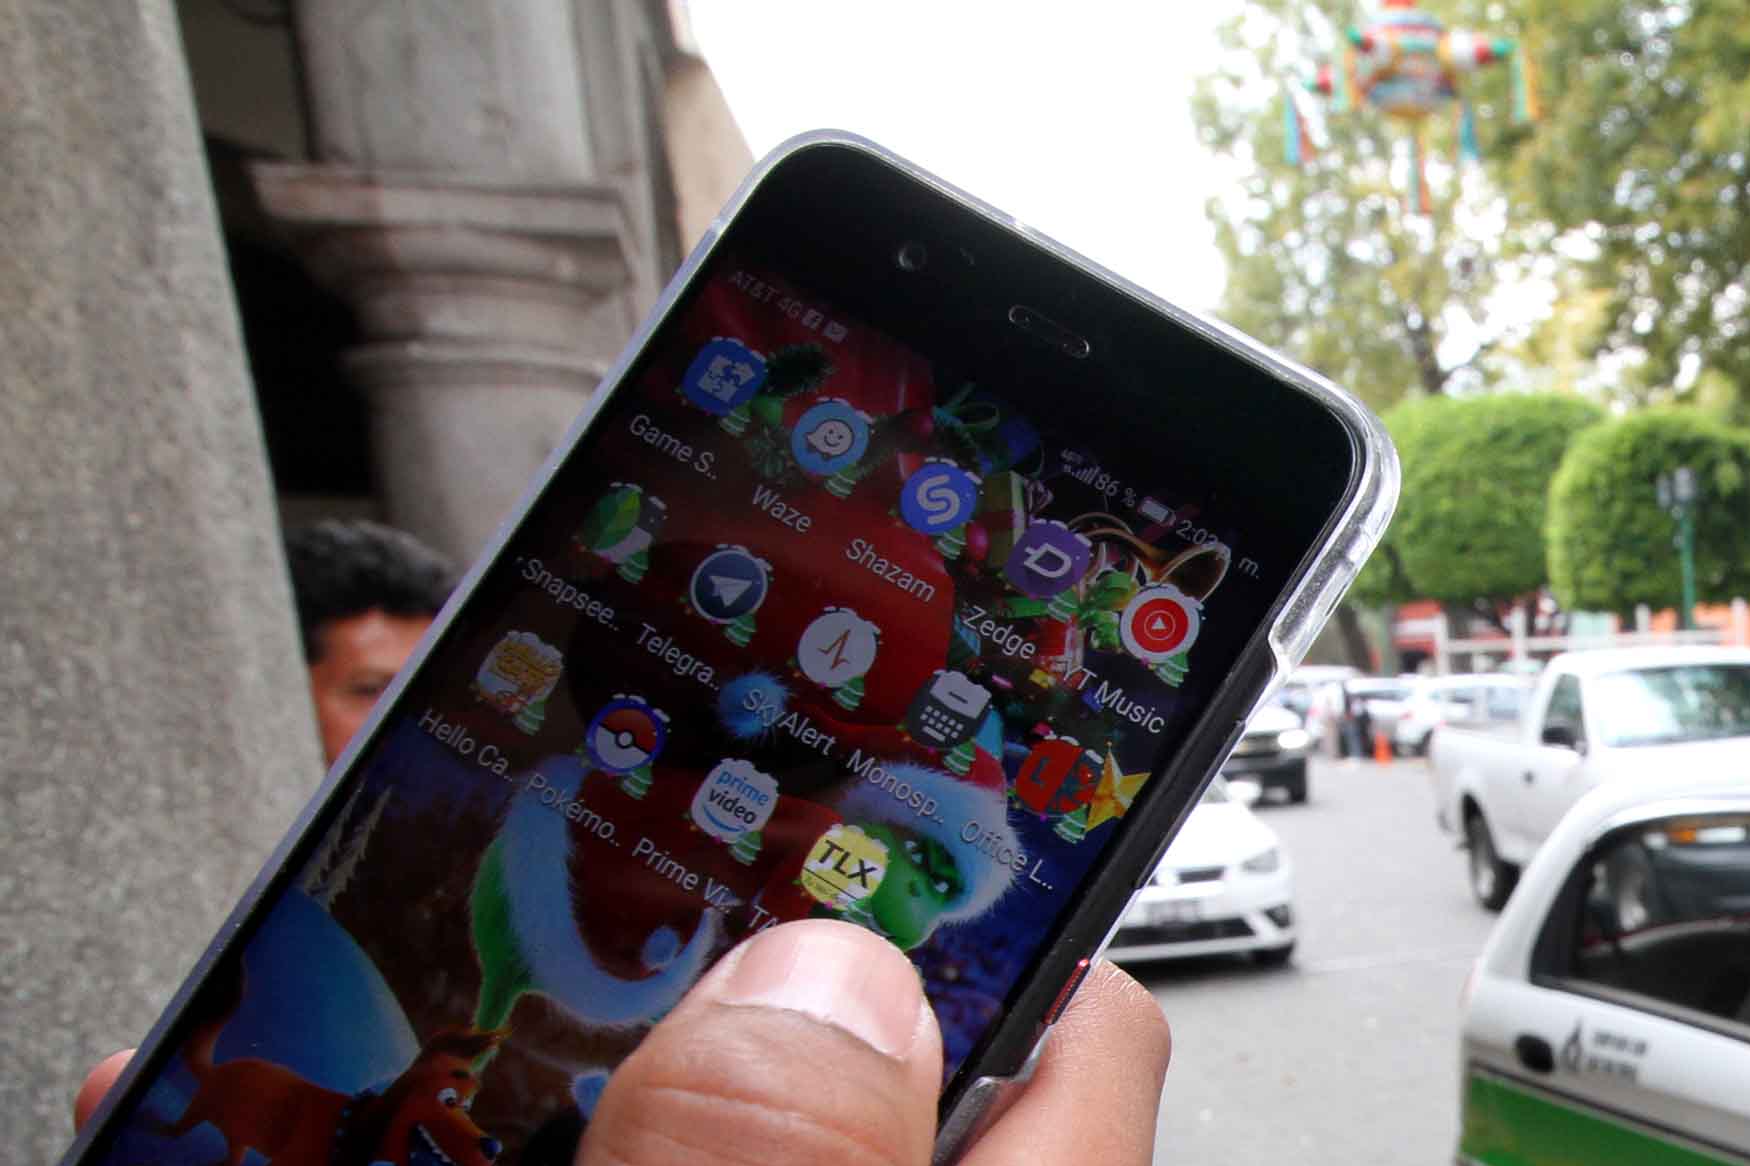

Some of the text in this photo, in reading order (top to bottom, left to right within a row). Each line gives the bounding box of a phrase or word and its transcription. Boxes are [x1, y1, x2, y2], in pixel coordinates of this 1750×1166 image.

[629, 414, 693, 463] Game
[753, 484, 812, 533] Waze
[845, 537, 936, 602] Shazam
[962, 603, 1036, 660] Zedge
[743, 688, 837, 756] SkyAlert
[1060, 659, 1166, 734] YT Music
[417, 707, 476, 753] Hello
[708, 788, 757, 825] video
[716, 770, 769, 807] prime
[632, 837, 699, 891] Prime
[818, 839, 878, 889] TLX
[960, 818, 1028, 873] Office
